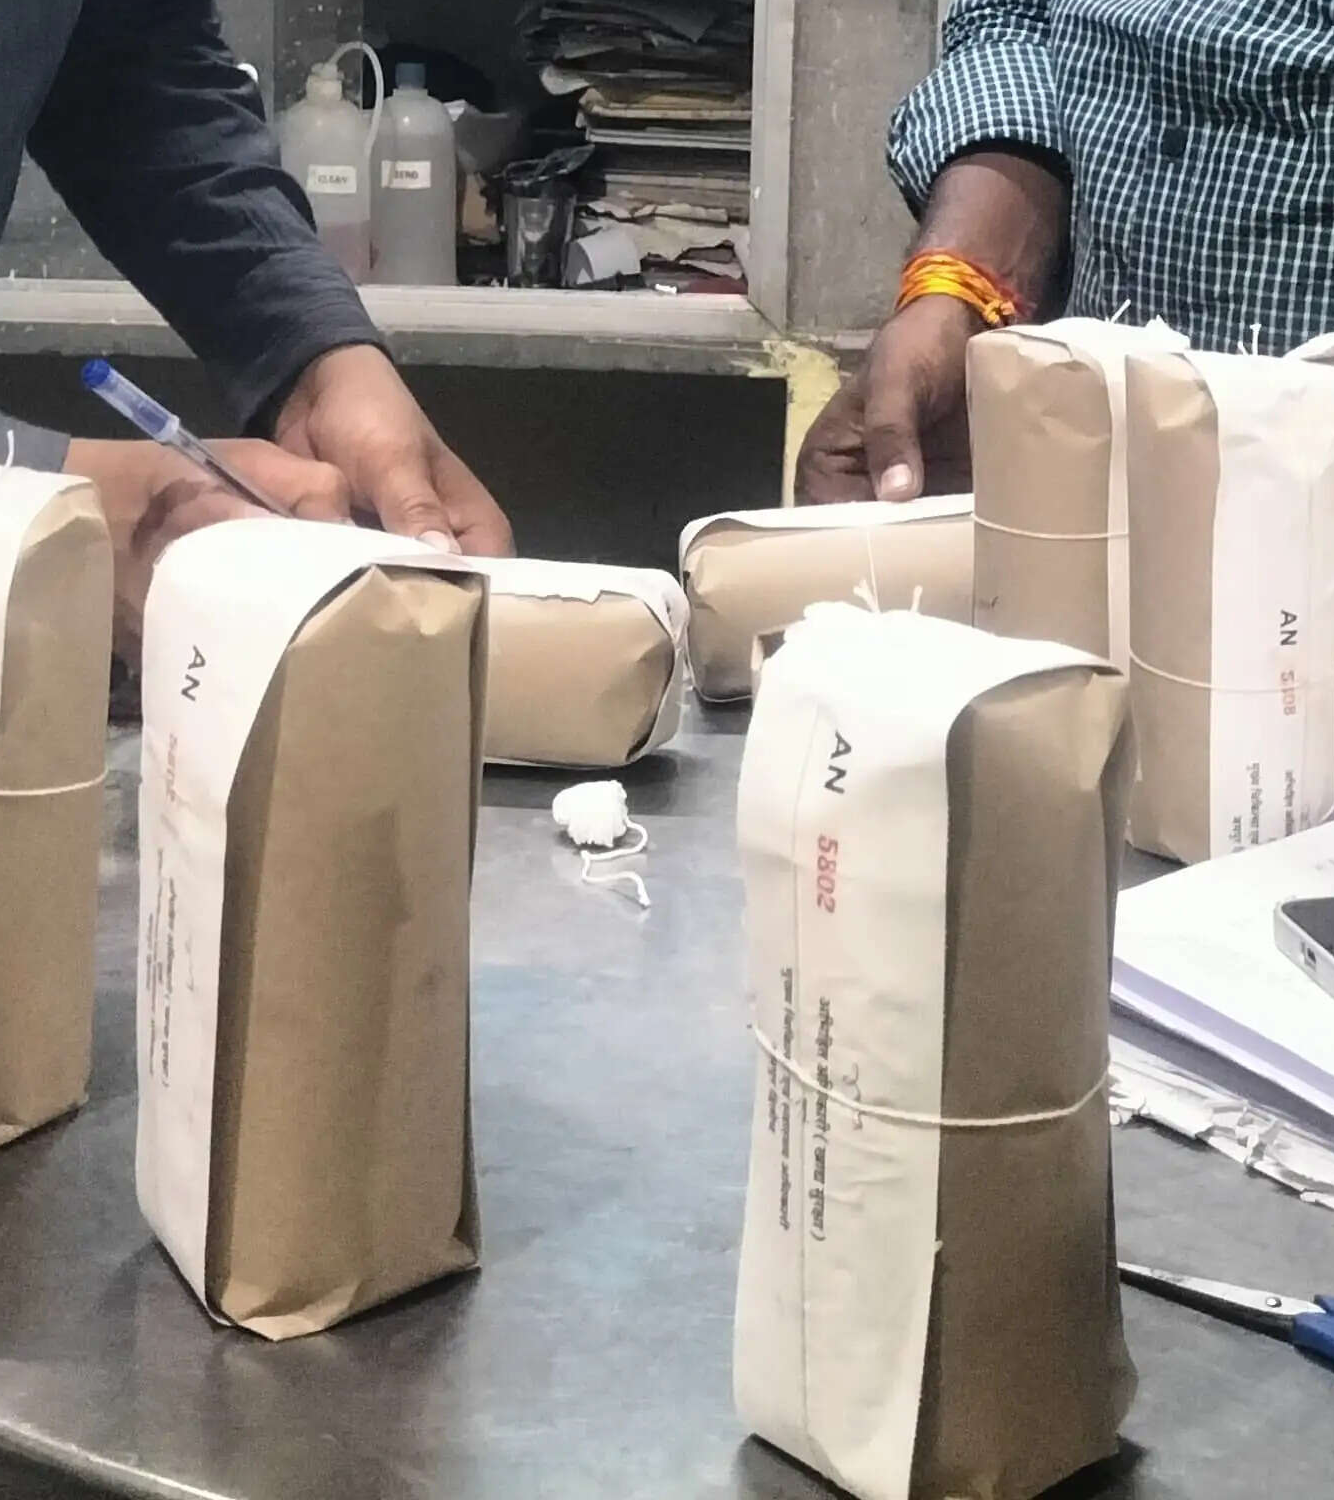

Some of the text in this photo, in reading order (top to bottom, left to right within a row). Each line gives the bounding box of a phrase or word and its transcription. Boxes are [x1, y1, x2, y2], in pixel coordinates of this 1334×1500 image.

[1280, 609, 1298, 646] AN
[181, 645, 206, 701] AN
[817, 730, 852, 914] AN 5802
